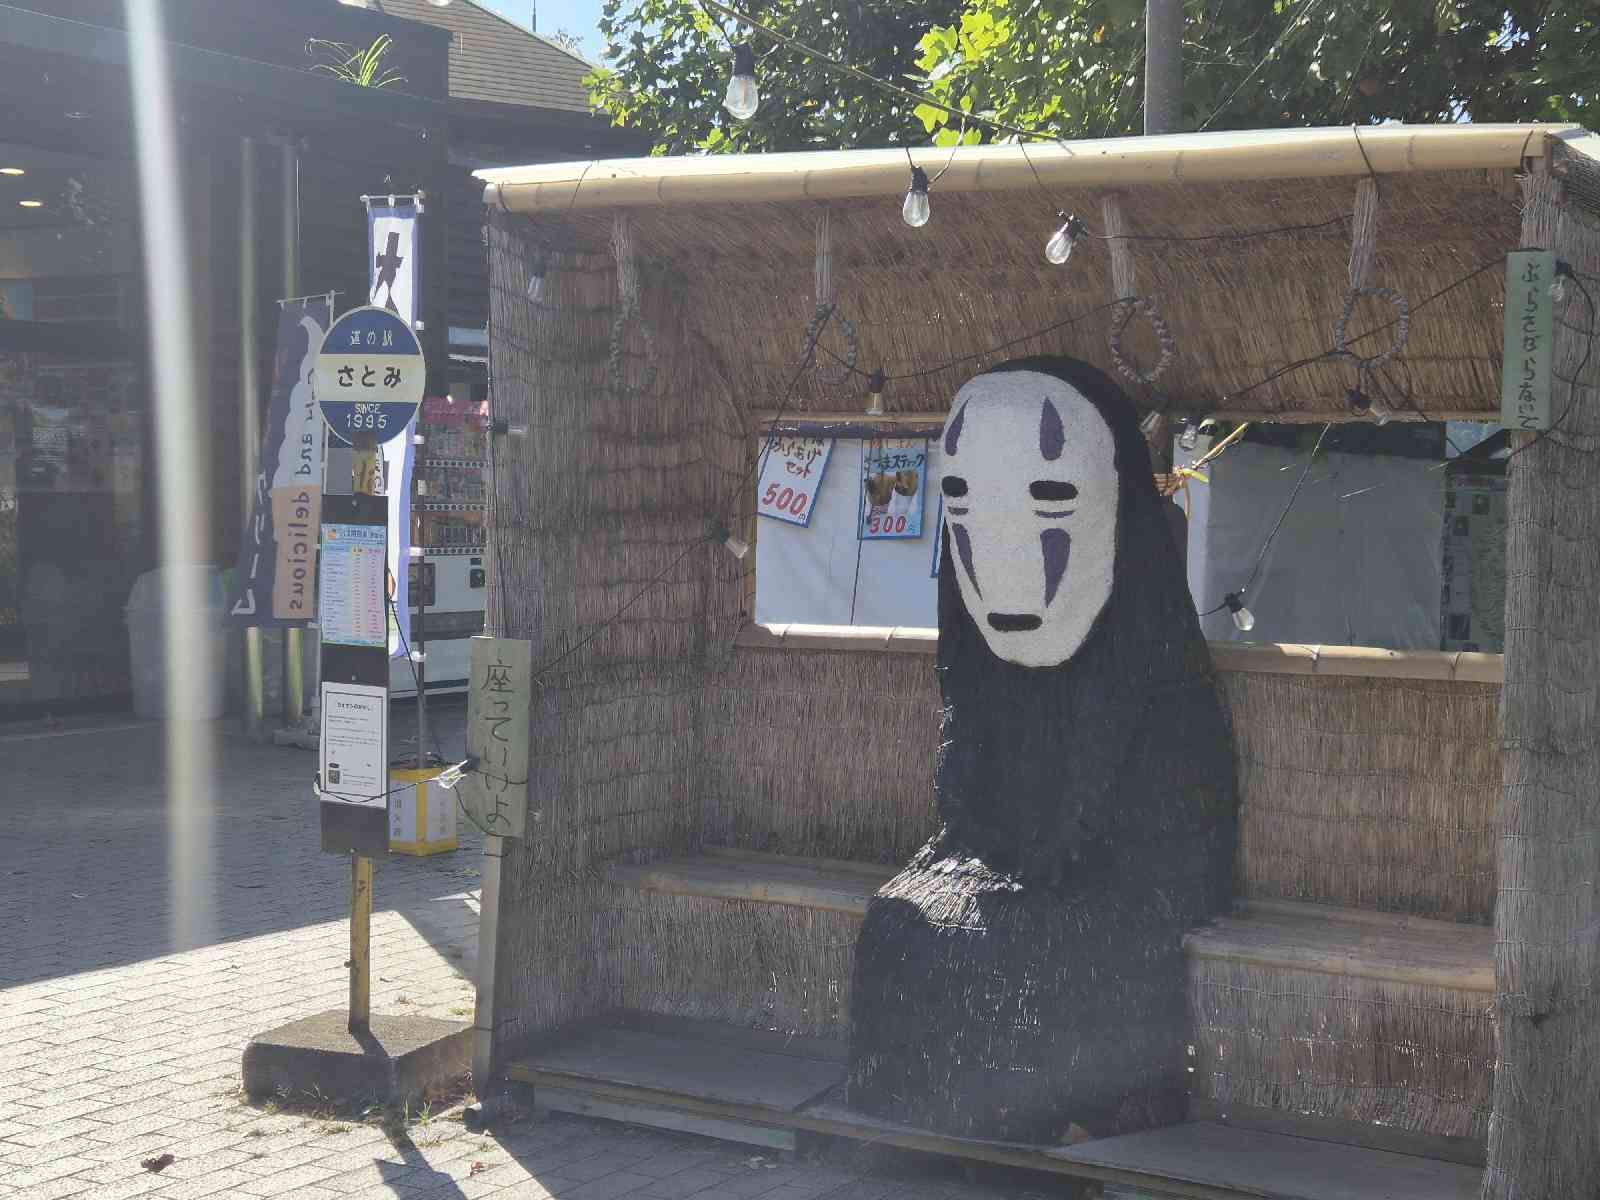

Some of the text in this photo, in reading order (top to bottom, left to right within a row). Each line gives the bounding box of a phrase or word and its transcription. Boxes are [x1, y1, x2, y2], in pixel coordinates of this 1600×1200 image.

[350, 328, 393, 346] 道の駅
[337, 365, 402, 389] さとみ
[355, 403, 381, 414] SINCE
[346, 413, 389, 429] 1995
[481, 659, 515, 828] 座っていいよ
